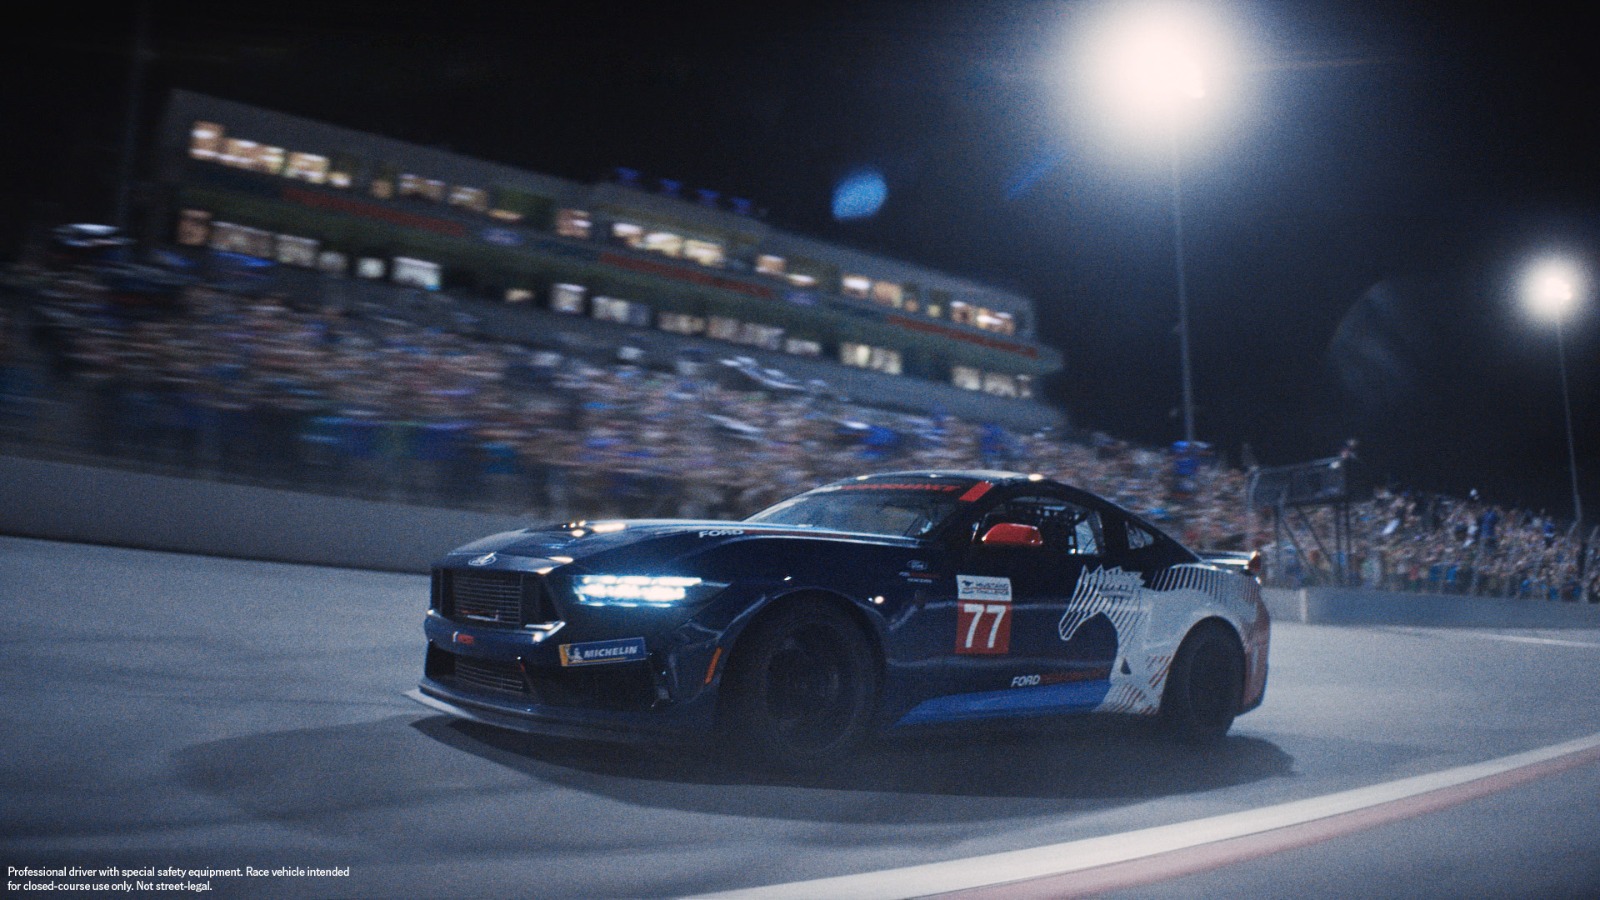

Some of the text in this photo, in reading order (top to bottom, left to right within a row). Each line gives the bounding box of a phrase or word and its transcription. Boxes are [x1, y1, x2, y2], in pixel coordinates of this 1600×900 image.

[699, 529, 744, 538] FORD
[963, 603, 1006, 648] 77
[583, 645, 638, 658] MICHELIN
[1010, 674, 1041, 687] FORD
